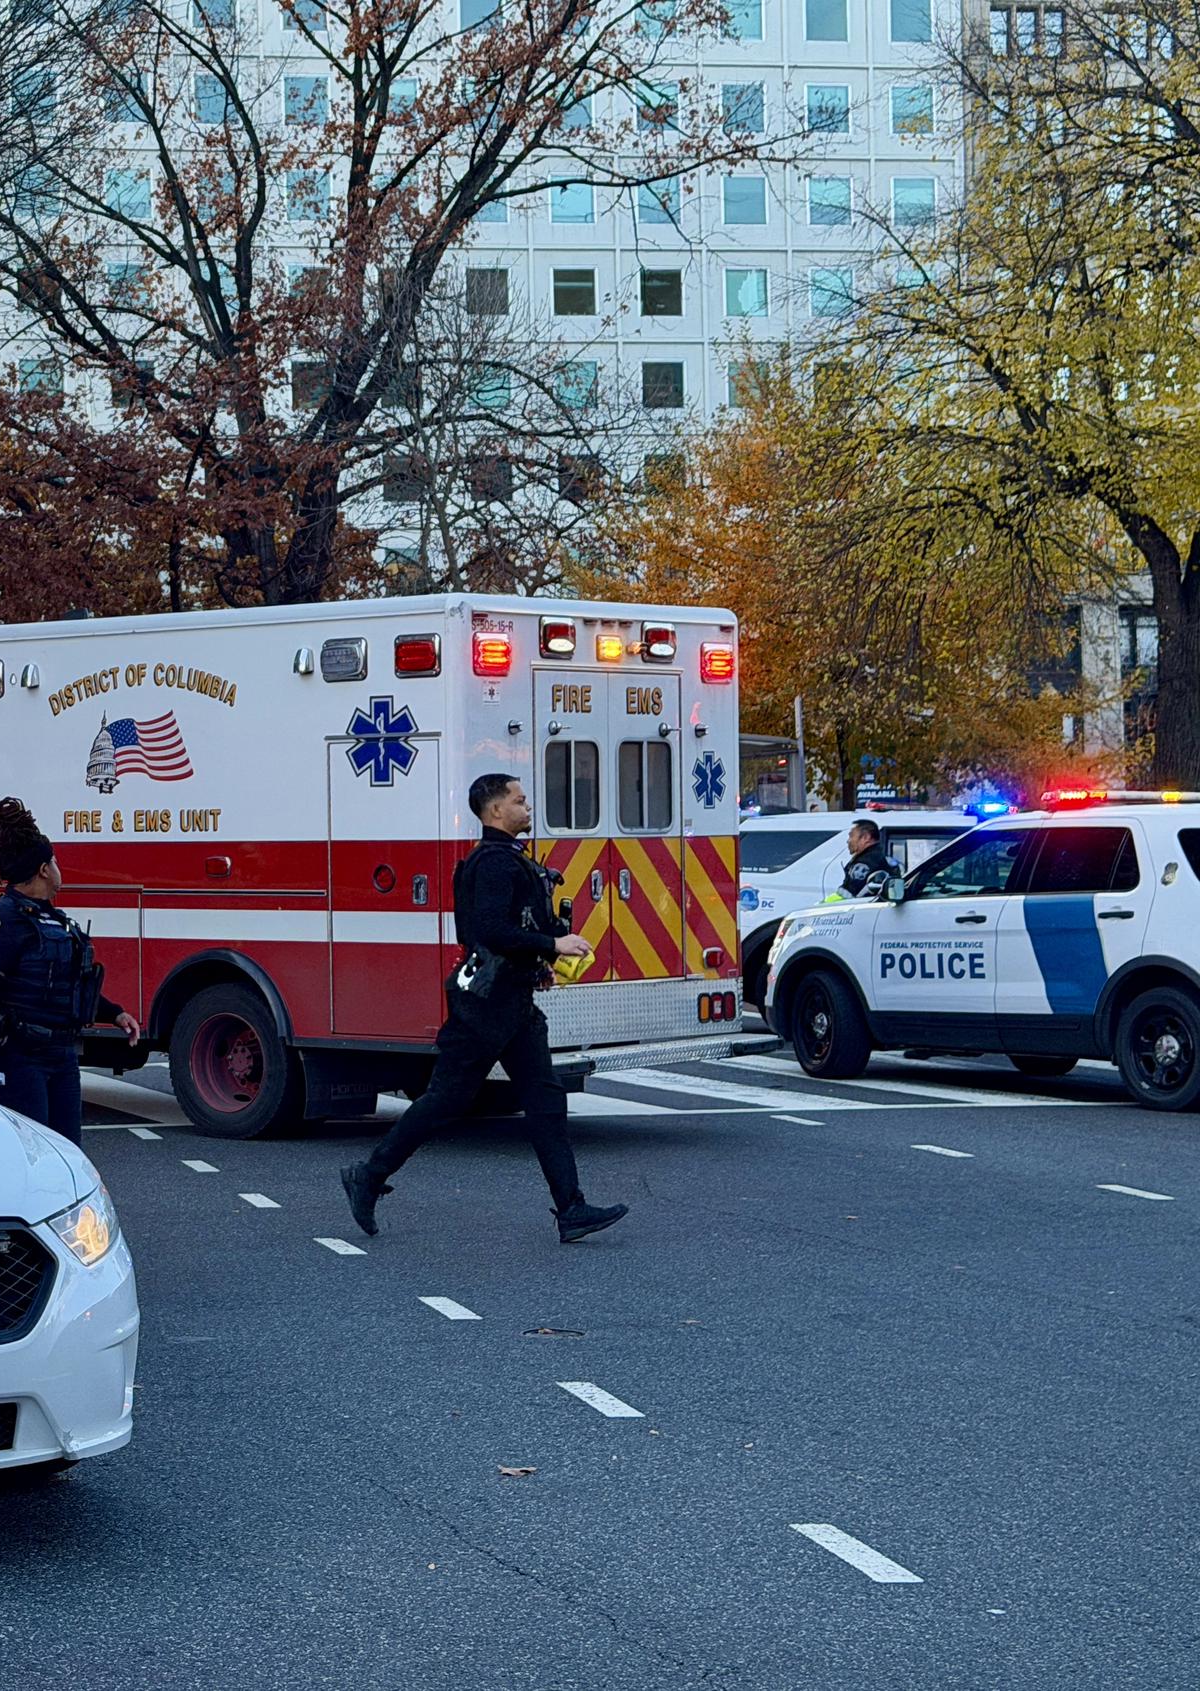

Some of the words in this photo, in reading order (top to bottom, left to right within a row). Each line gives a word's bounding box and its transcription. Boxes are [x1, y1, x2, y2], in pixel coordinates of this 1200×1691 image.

[48, 666, 120, 717] DISTRICT
[125, 663, 147, 687] OF
[153, 662, 238, 707] COLUMBIA
[552, 684, 592, 713] FIRE
[626, 687, 663, 715] EMS
[857, 790, 896, 798] AVAILABLE
[64, 810, 102, 833] FIRE
[111, 810, 124, 832] &
[134, 809, 171, 832] EMS
[180, 808, 221, 832] UNIT
[761, 900, 775, 908] DC
[811, 914, 854, 926] Homeland
[810, 928, 841, 939] ecurity
[911, 941, 952, 949] PROTECTIVE
[954, 941, 984, 949] SERVICE
[880, 952, 986, 979] POLICE
